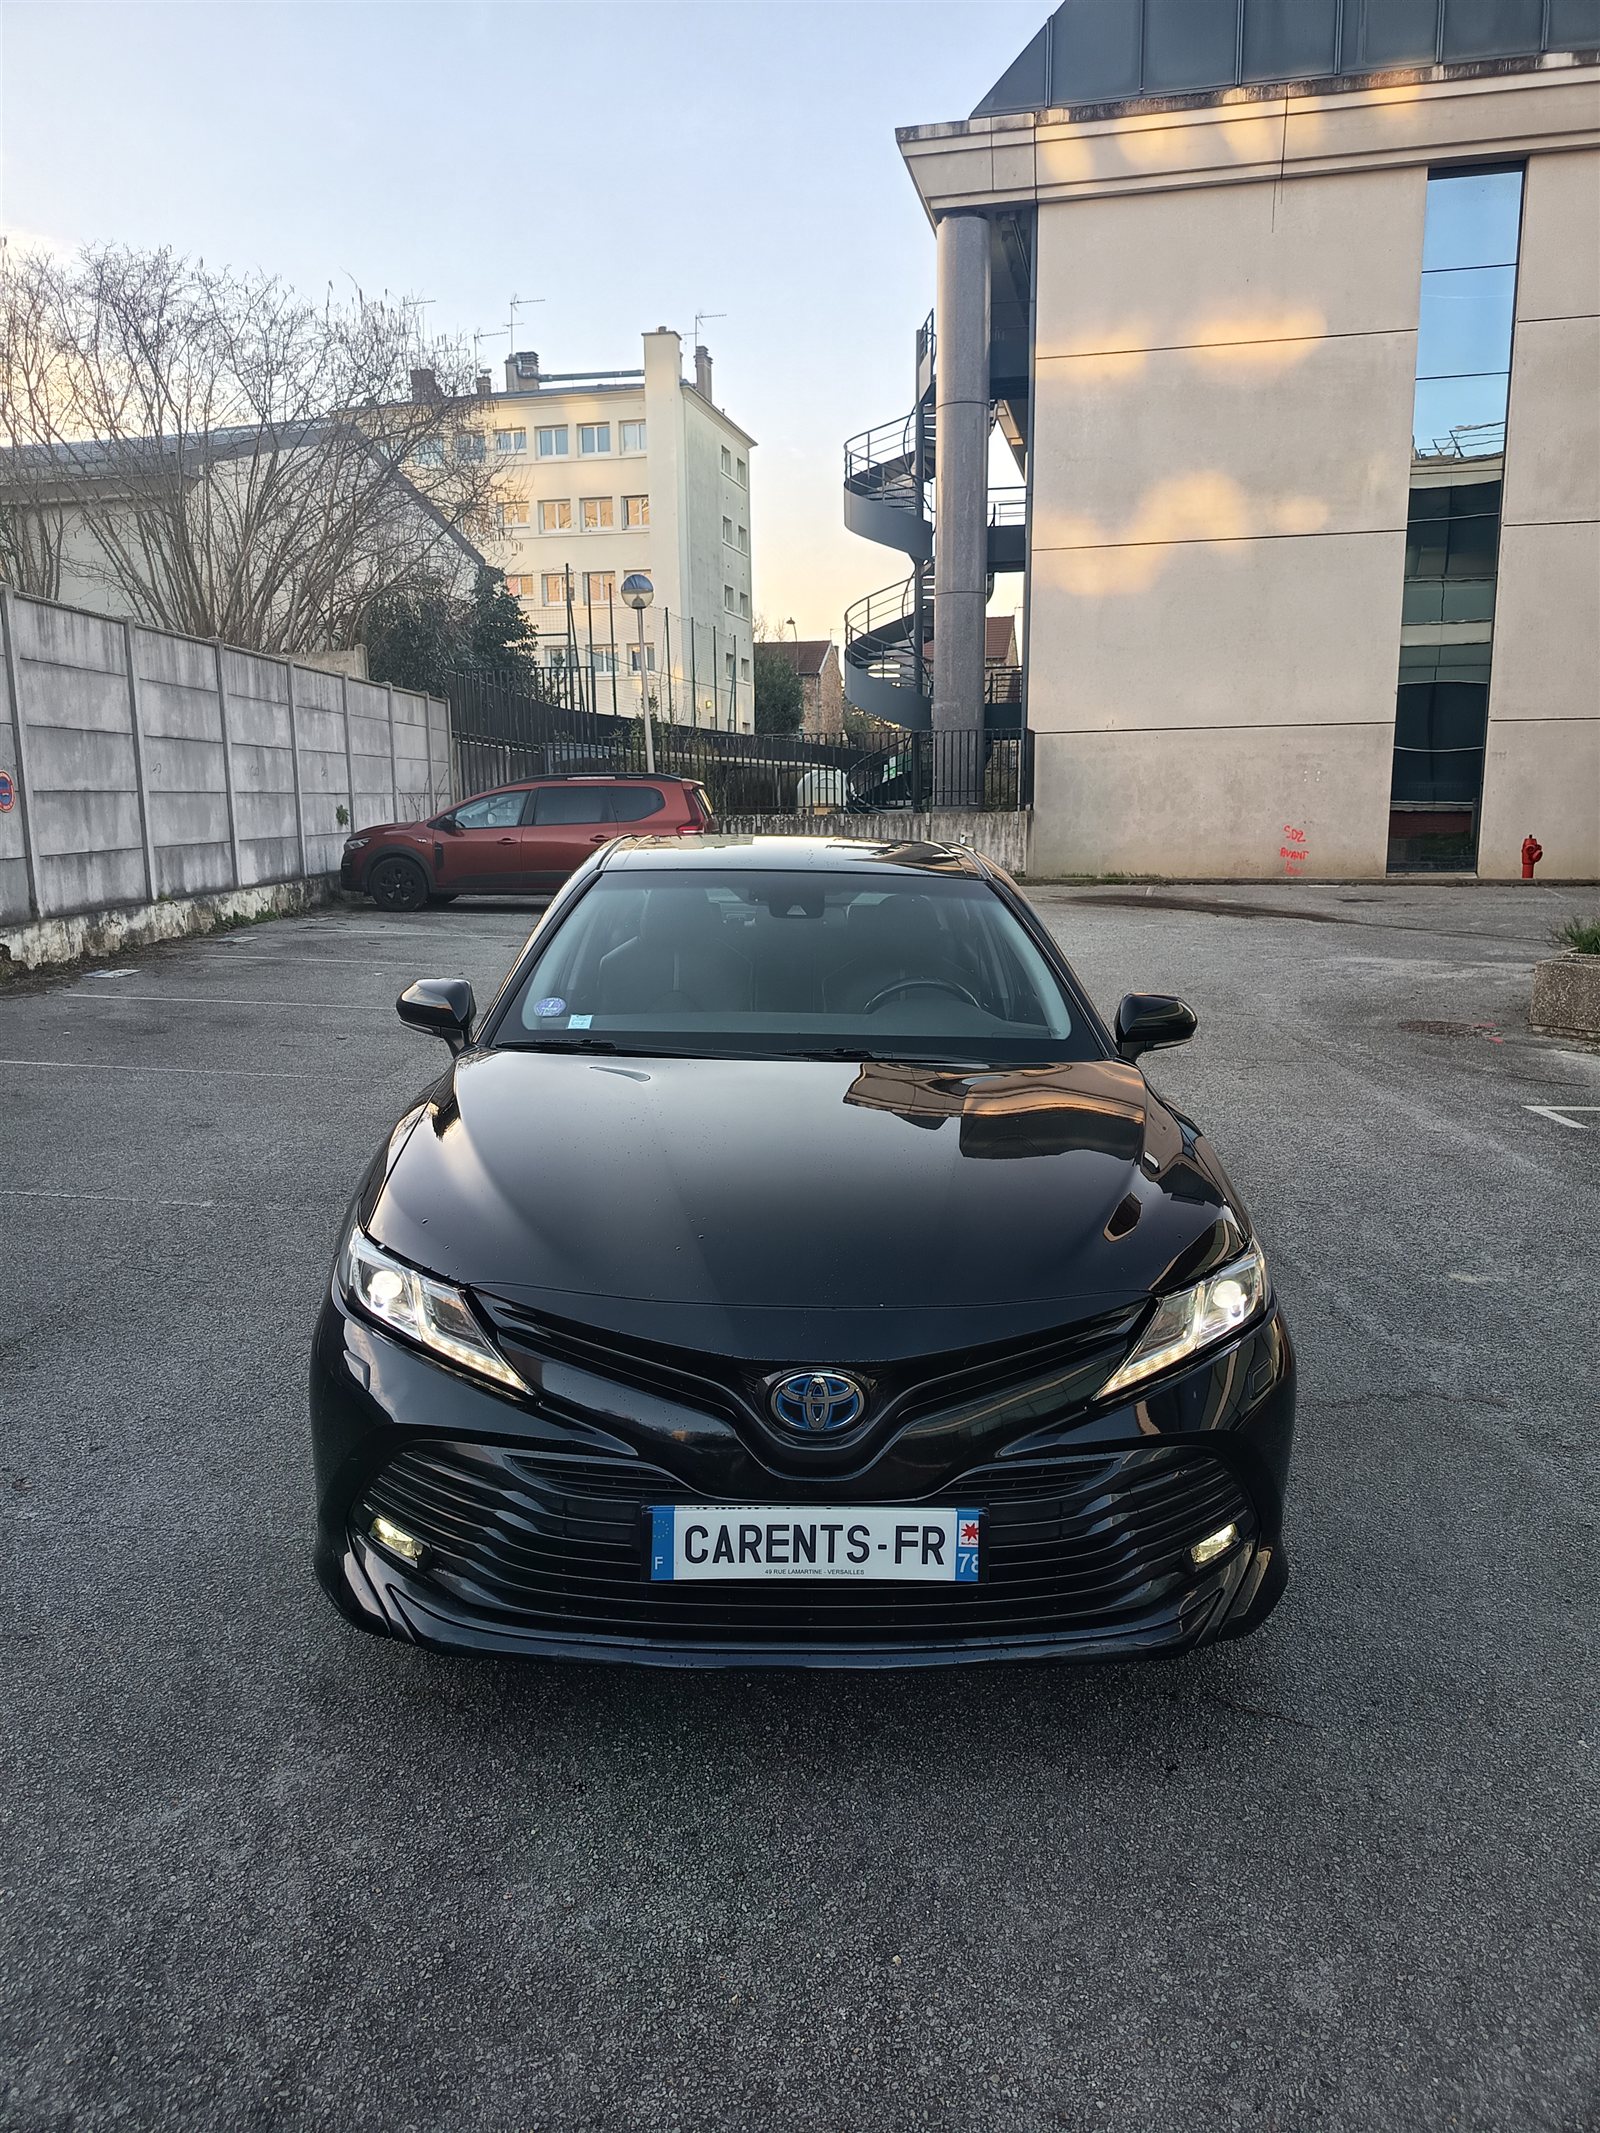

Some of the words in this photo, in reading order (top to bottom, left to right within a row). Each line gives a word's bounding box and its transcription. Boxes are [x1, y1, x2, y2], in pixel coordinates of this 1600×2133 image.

[684, 1524, 946, 1565] CARENTS-FR
[655, 1556, 663, 1570] F
[958, 1553, 979, 1573] 78
